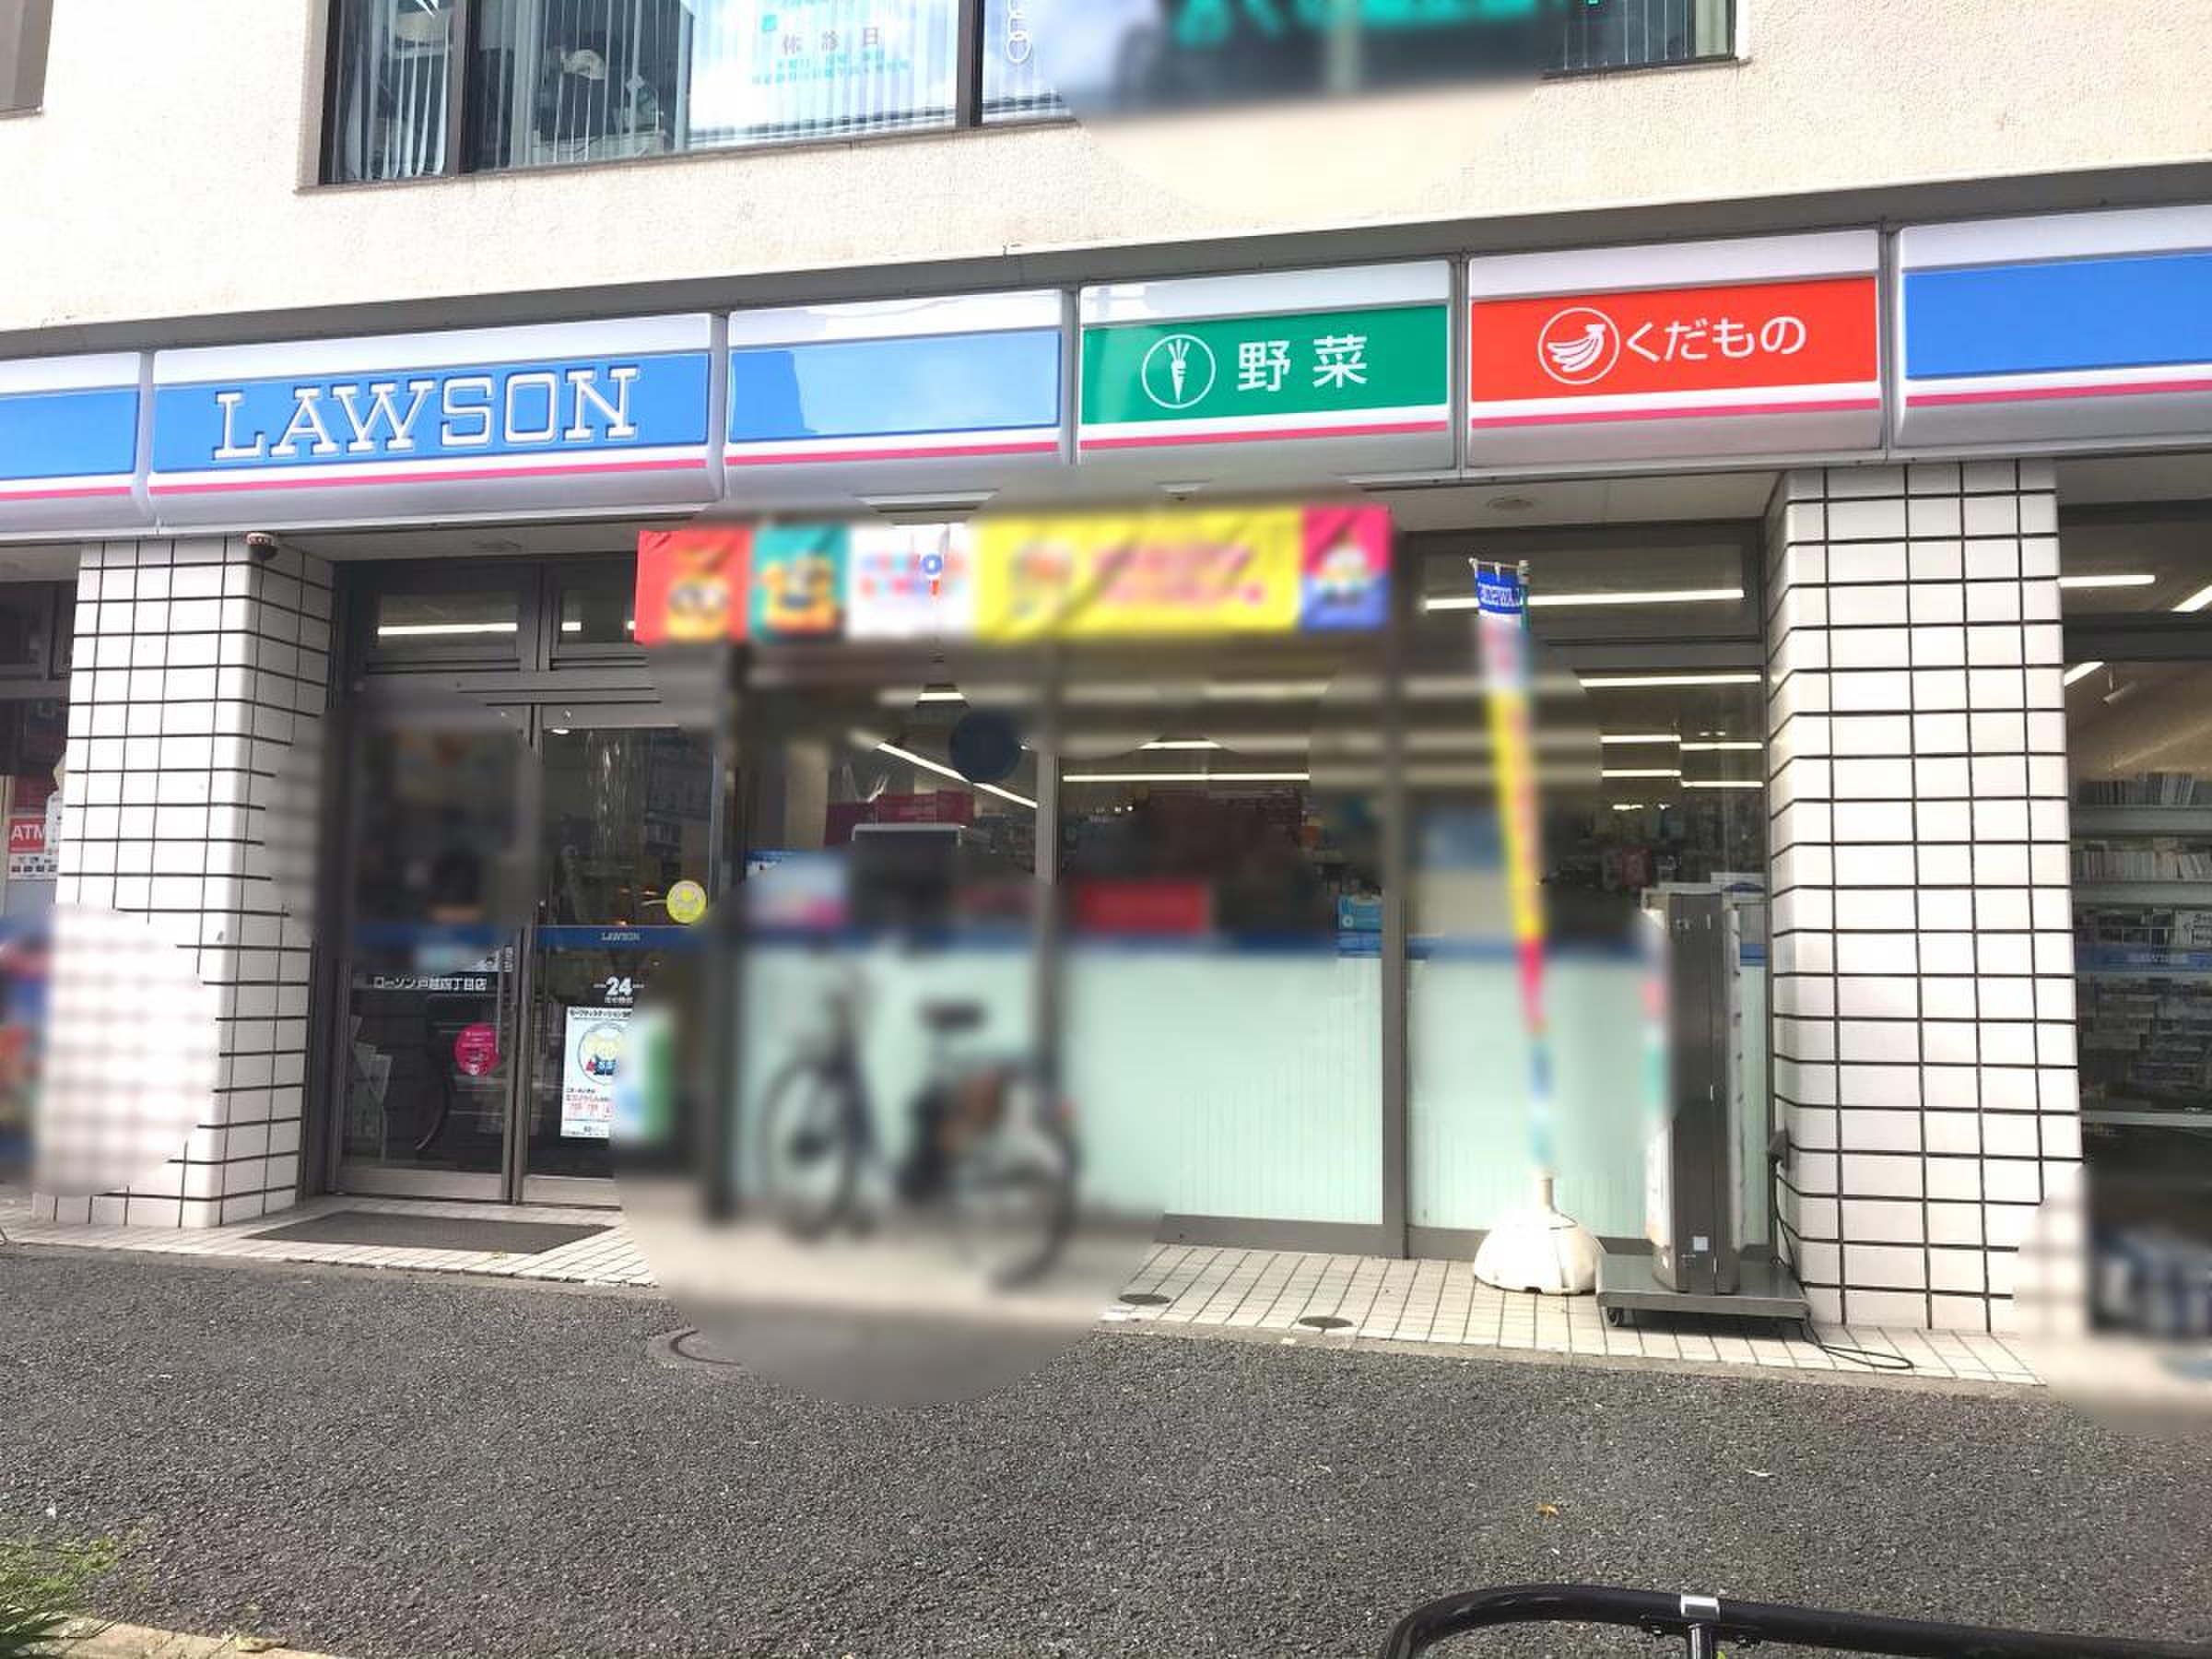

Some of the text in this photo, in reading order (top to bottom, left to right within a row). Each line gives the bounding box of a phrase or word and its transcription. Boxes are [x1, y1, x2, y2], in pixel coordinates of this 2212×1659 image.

[1237, 334, 1368, 393] 野菜
[1625, 315, 1807, 363] くだもの
[213, 365, 640, 459] LAWSON
[606, 976, 633, 995] 24
